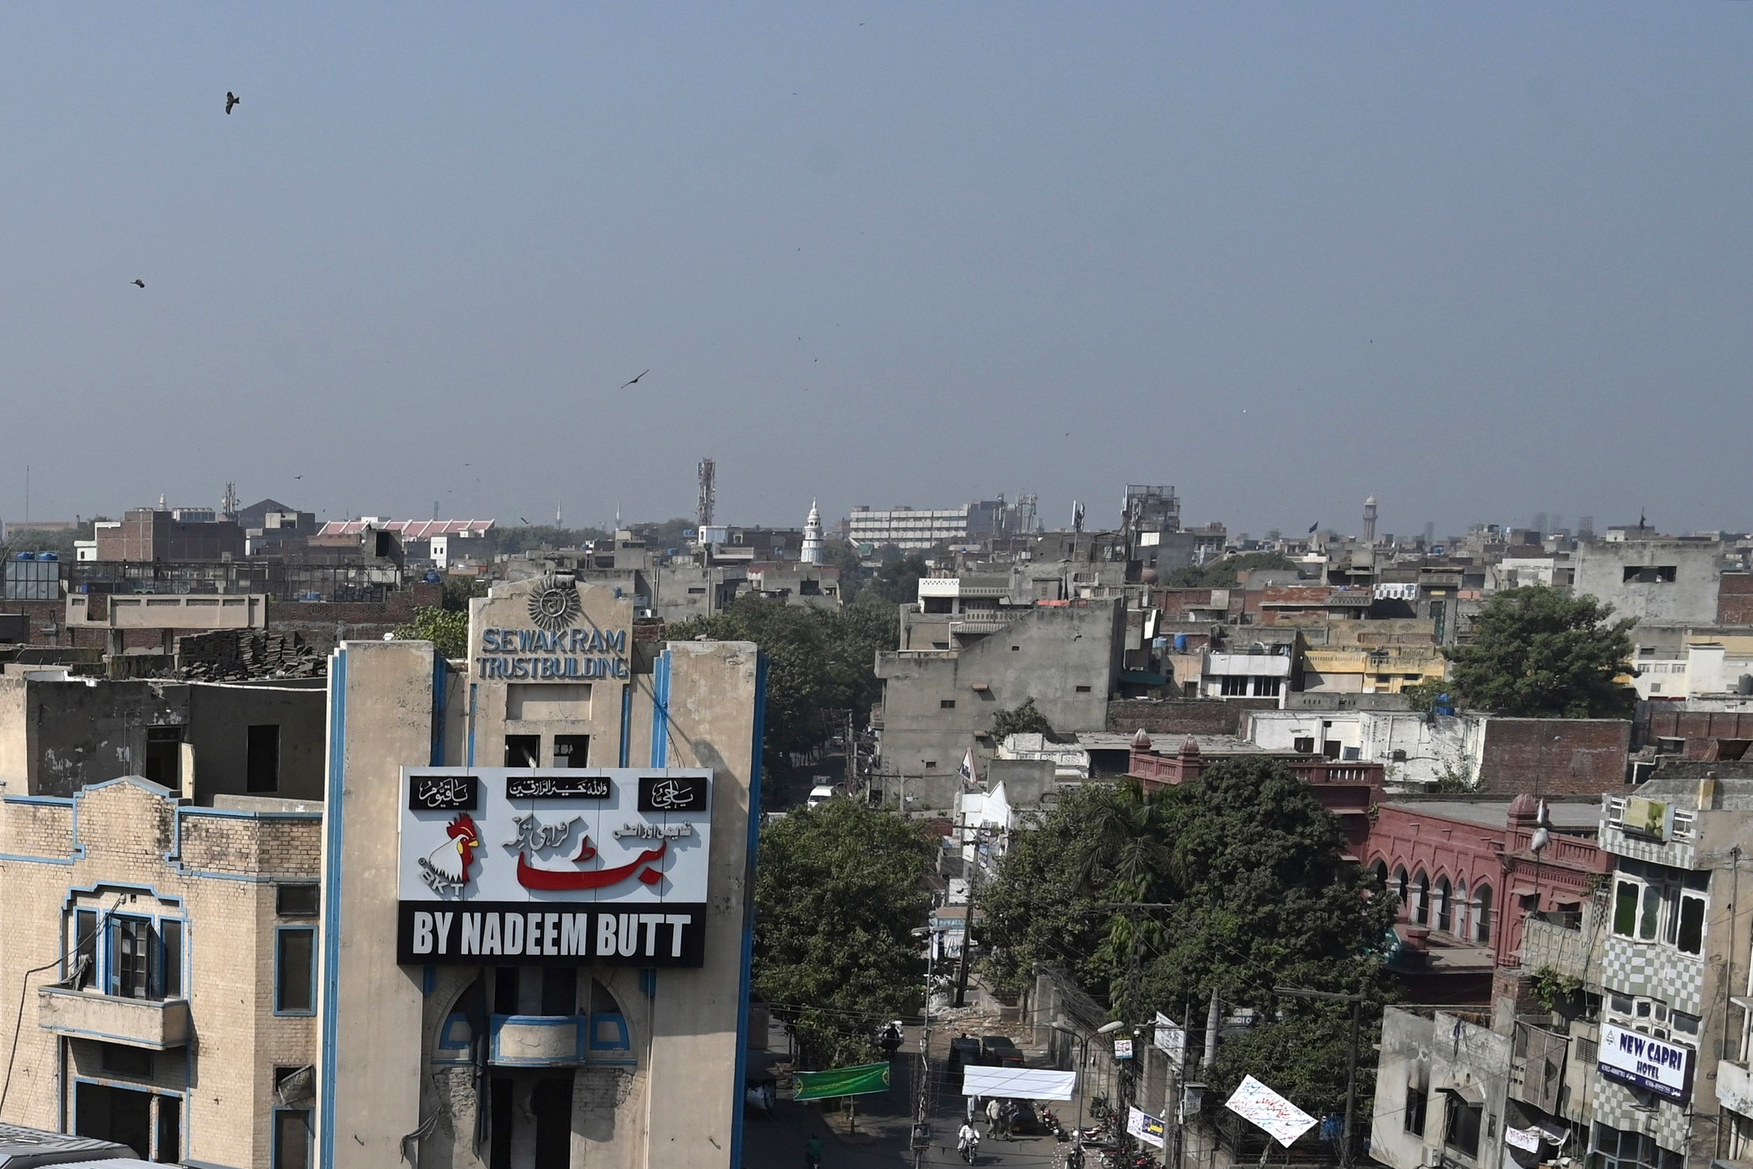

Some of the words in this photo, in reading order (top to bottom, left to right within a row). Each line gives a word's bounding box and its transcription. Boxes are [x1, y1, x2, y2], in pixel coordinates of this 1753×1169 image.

[482, 627, 568, 654] SEWAK
[568, 627, 627, 654] RAM
[476, 656, 541, 681] TRUST
[540, 656, 630, 681] BUILDING
[419, 867, 465, 897] BKT
[412, 911, 454, 955] BY
[460, 911, 588, 956] NADEEM
[596, 912, 692, 958] BUTT
[1619, 1032, 1646, 1058] NEW
[1647, 1042, 1683, 1071] CAPRI
[1636, 1060, 1660, 1080] HOTEL
